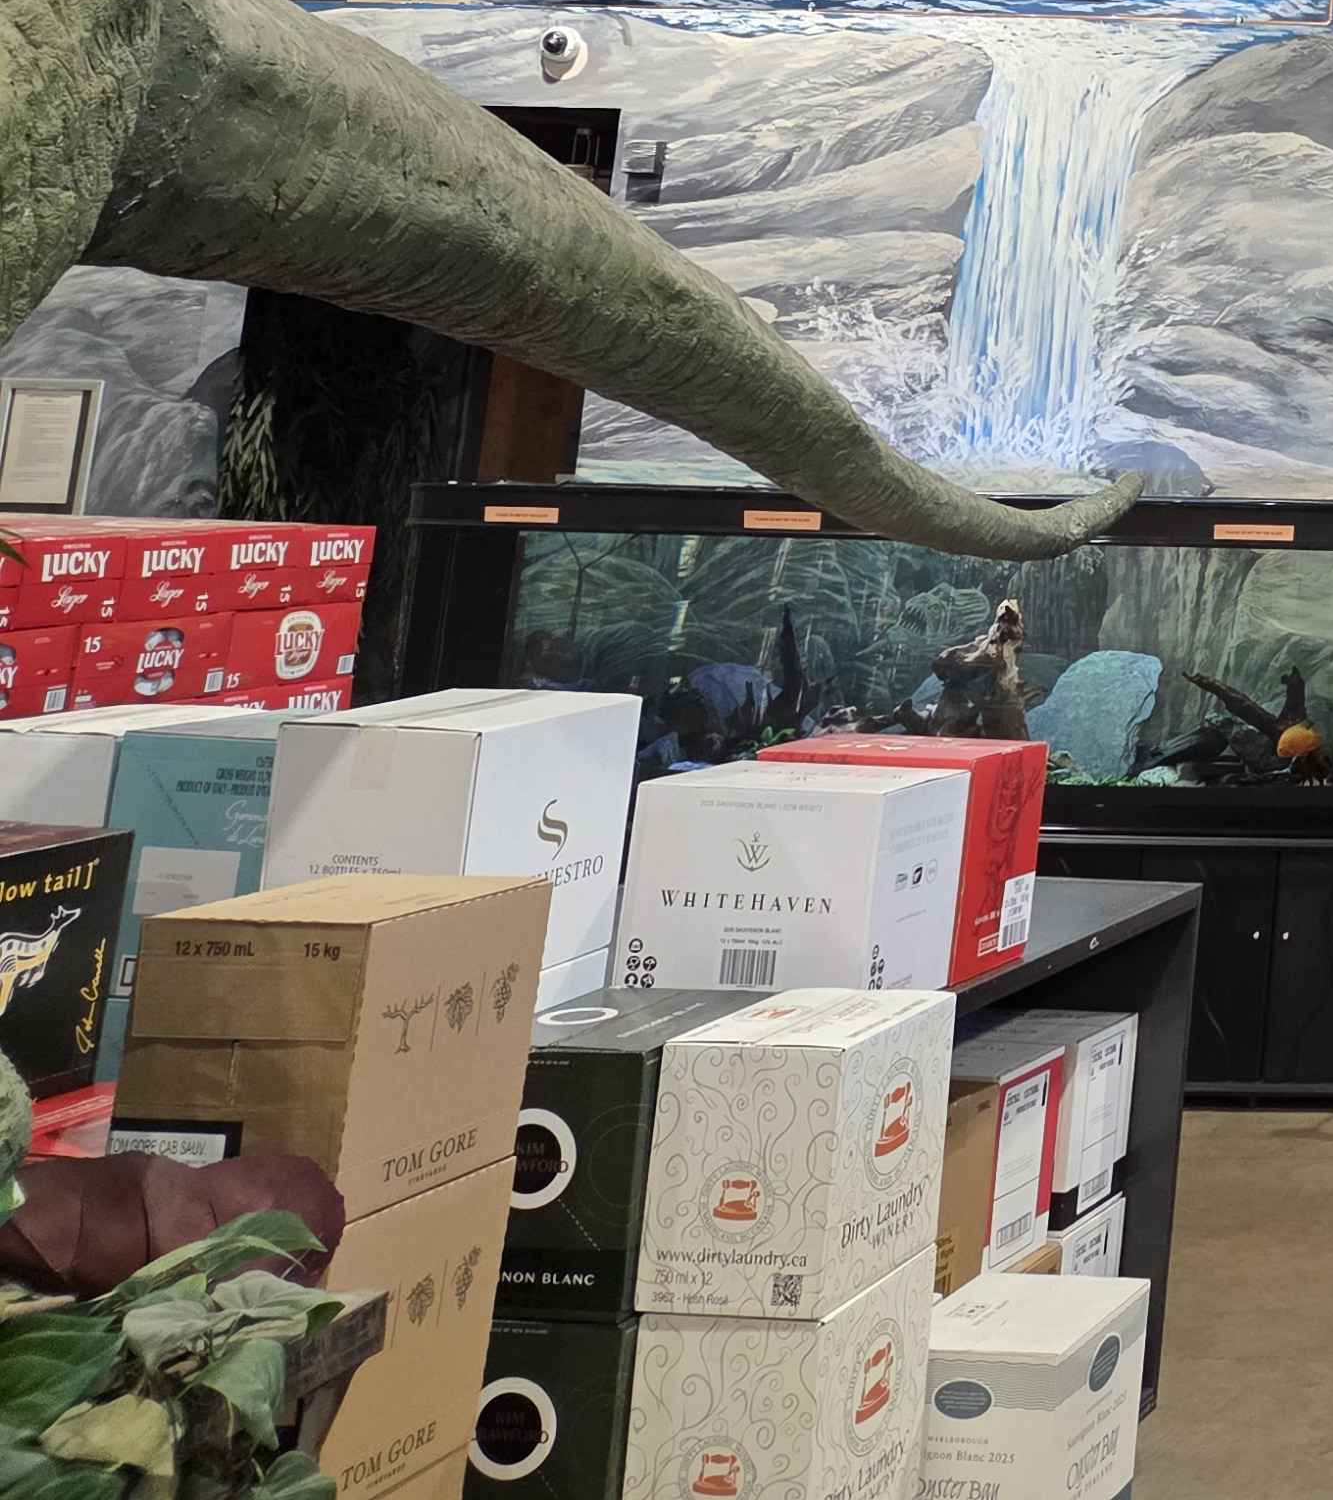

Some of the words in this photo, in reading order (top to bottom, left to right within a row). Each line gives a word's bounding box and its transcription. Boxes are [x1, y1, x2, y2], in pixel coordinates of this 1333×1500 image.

[141, 547, 205, 578] LUCKY
[230, 541, 289, 570] LUCKY
[310, 539, 365, 567] LUCKY
[41, 551, 110, 582] LUCKY
[84, 636, 102, 653] 15
[274, 629, 326, 658] LUCKY
[136, 649, 184, 674] LUCKY
[227, 672, 241, 689] 15
[332, 854, 379, 867] CONTENTS
[534, 855, 604, 888] VESTRO
[661, 889, 833, 914] WHITEHAVEN
[175, 940, 191, 955] 12
[194, 945, 202, 956] x
[206, 941, 231, 956] 750
[234, 941, 255, 957] mL
[303, 942, 319, 958] 15
[323, 943, 341, 961] kg
[132, 1138, 158, 1155] GORE
[159, 1139, 179, 1156] CAB
[382, 1153, 427, 1183] TOM
[429, 1128, 479, 1165] GORE
[841, 1213, 871, 1249] Dirty
[877, 1181, 923, 1226] Laundry
[656, 1248, 807, 1269] www.dirtylaundry.ca
[541, 1272, 595, 1286] BLANC
[655, 1269, 674, 1284] 750
[341, 1450, 384, 1491] TOM
[388, 1419, 437, 1465] GORE
[922, 1450, 953, 1462] ignon
[956, 1450, 985, 1463] Blanc
[988, 1452, 1016, 1464] 2025
